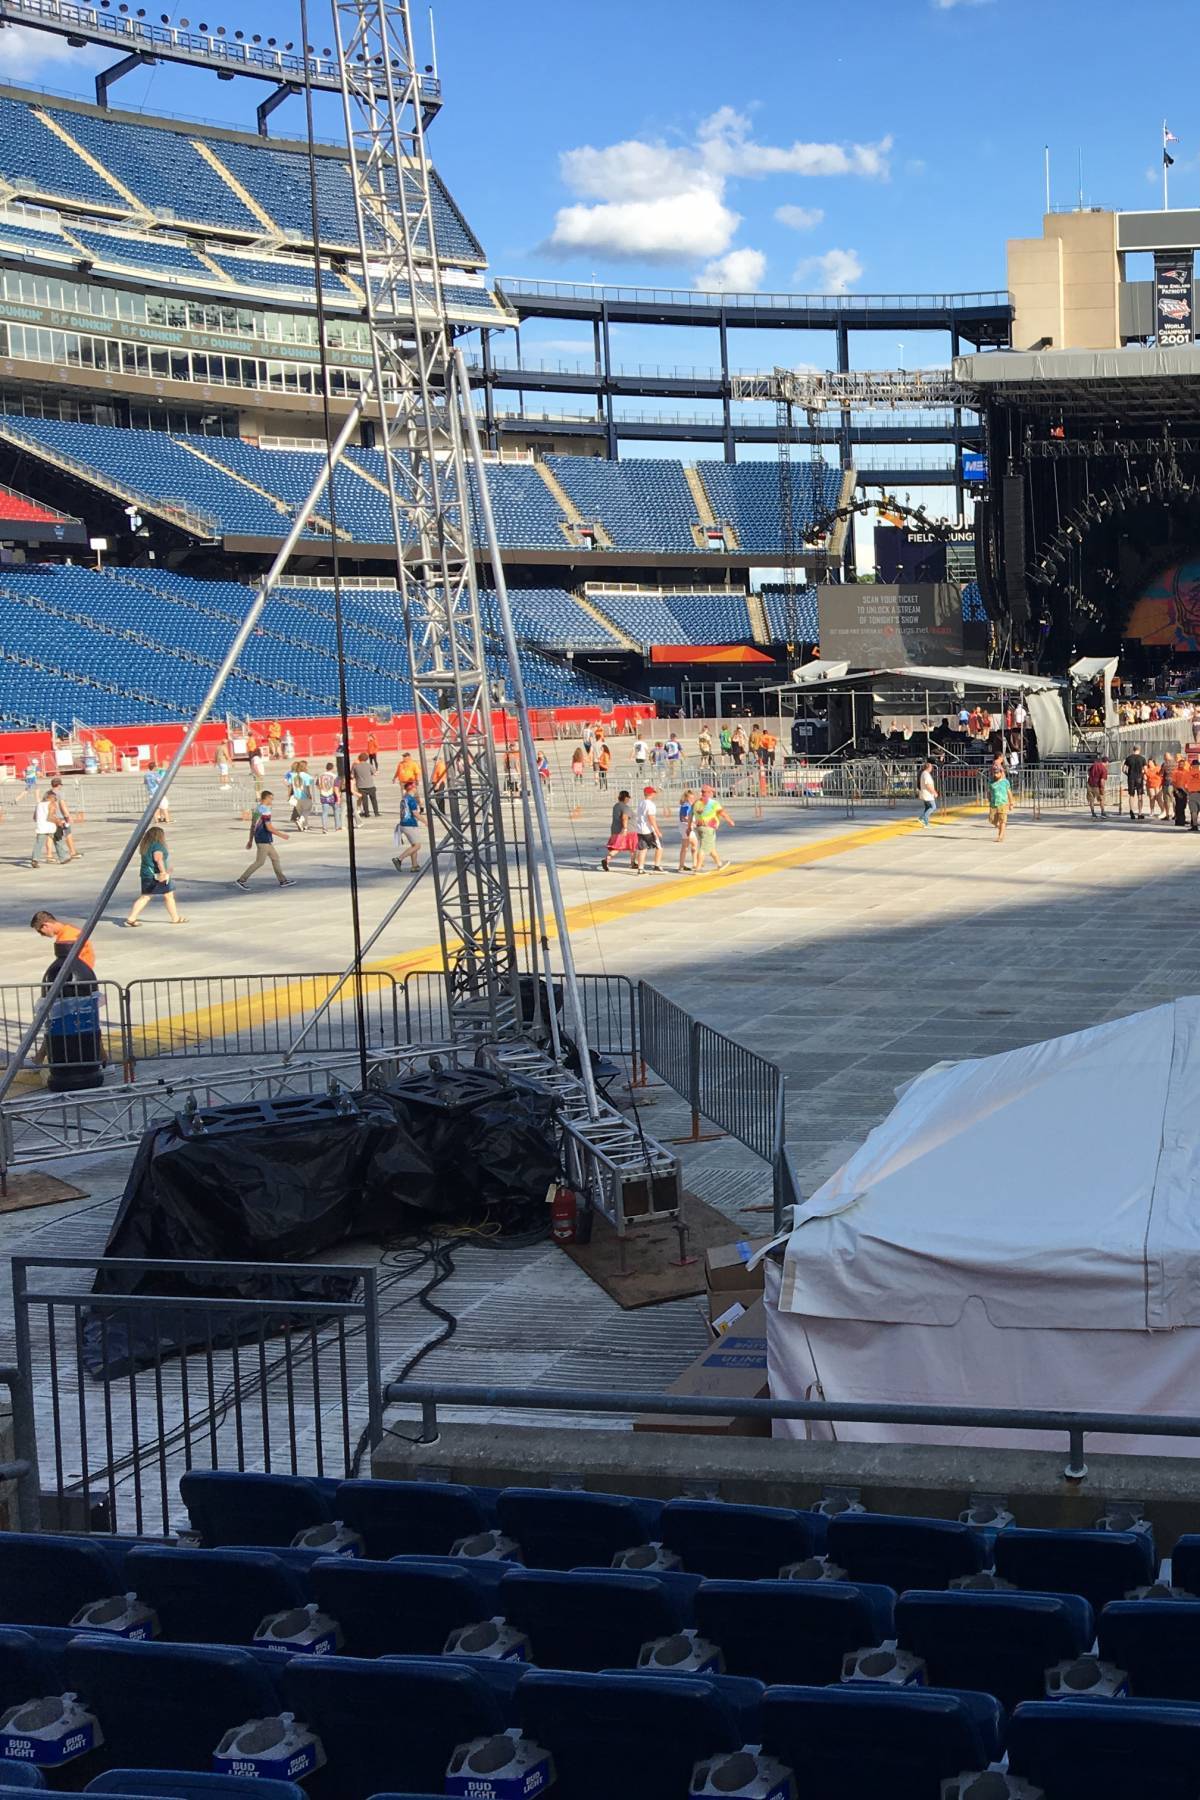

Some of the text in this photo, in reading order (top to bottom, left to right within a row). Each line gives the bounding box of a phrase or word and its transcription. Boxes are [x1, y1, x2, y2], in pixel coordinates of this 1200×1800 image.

[70, 316, 113, 332] DUNKIN'
[139, 328, 183, 342] DUNKIN'
[1160, 335, 1189, 344] 2001
[280, 346, 321, 360] DUNKIN
[862, 595, 918, 604] SCAN YOUR TICKET
[857, 606, 865, 614] TO
[866, 606, 890, 614] UNLOCK
[896, 605, 920, 613] STREAM
[859, 615, 919, 624] OF TONIGHT'S SHOW
[9, 1739, 31, 1749] BUD
[66, 1733, 84, 1746] BUD
[4, 1746, 36, 1758] LIGHT
[63, 1739, 87, 1755] LIGHT
[231, 1761, 256, 1771] BUD
[290, 1754, 307, 1768] BUD
[467, 1781, 492, 1791] BUD
[464, 1789, 497, 1799] LIGHT
